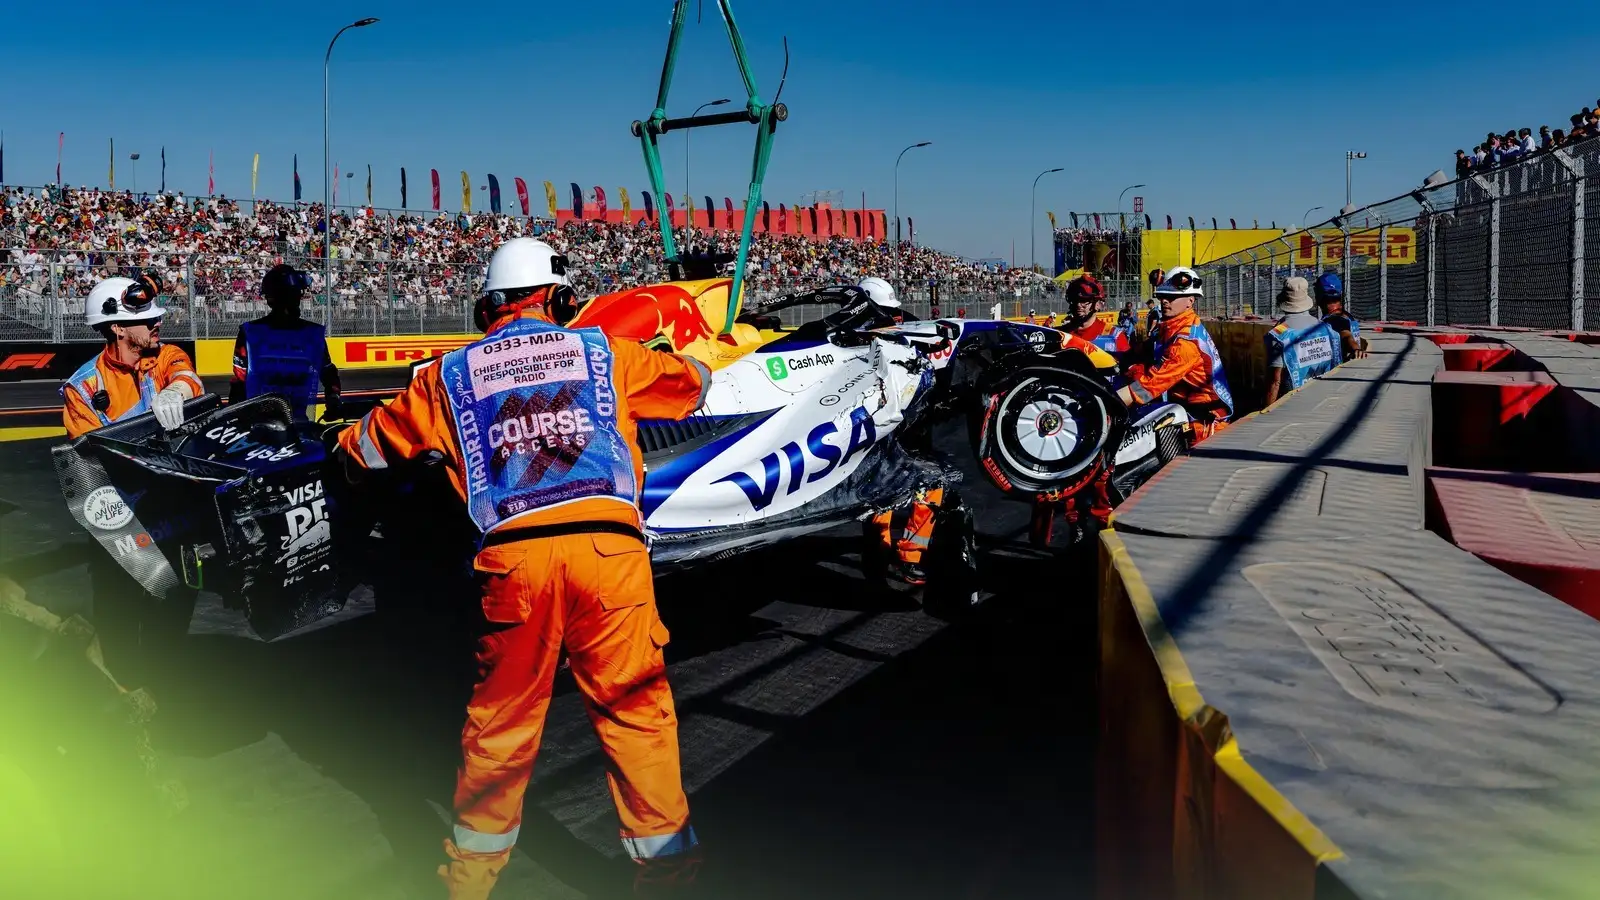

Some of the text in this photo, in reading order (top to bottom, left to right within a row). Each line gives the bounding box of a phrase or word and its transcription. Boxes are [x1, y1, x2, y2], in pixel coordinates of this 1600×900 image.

[1300, 234, 1410, 259] PRELLI
[763, 296, 787, 306] HUGO
[345, 340, 476, 362] PIRE
[483, 332, 565, 355] 0333-MAD
[473, 349, 582, 378] CHIEF POST MARSHAL
[483, 359, 575, 383] RESPONSIBLE FOR
[788, 356, 815, 371] Cash
[816, 351, 834, 367] App
[514, 372, 546, 384] RADIO
[487, 407, 595, 450] COURSE
[501, 433, 586, 459] ACCESS
[710, 405, 876, 512] VISA
[282, 480, 324, 506] VISA
